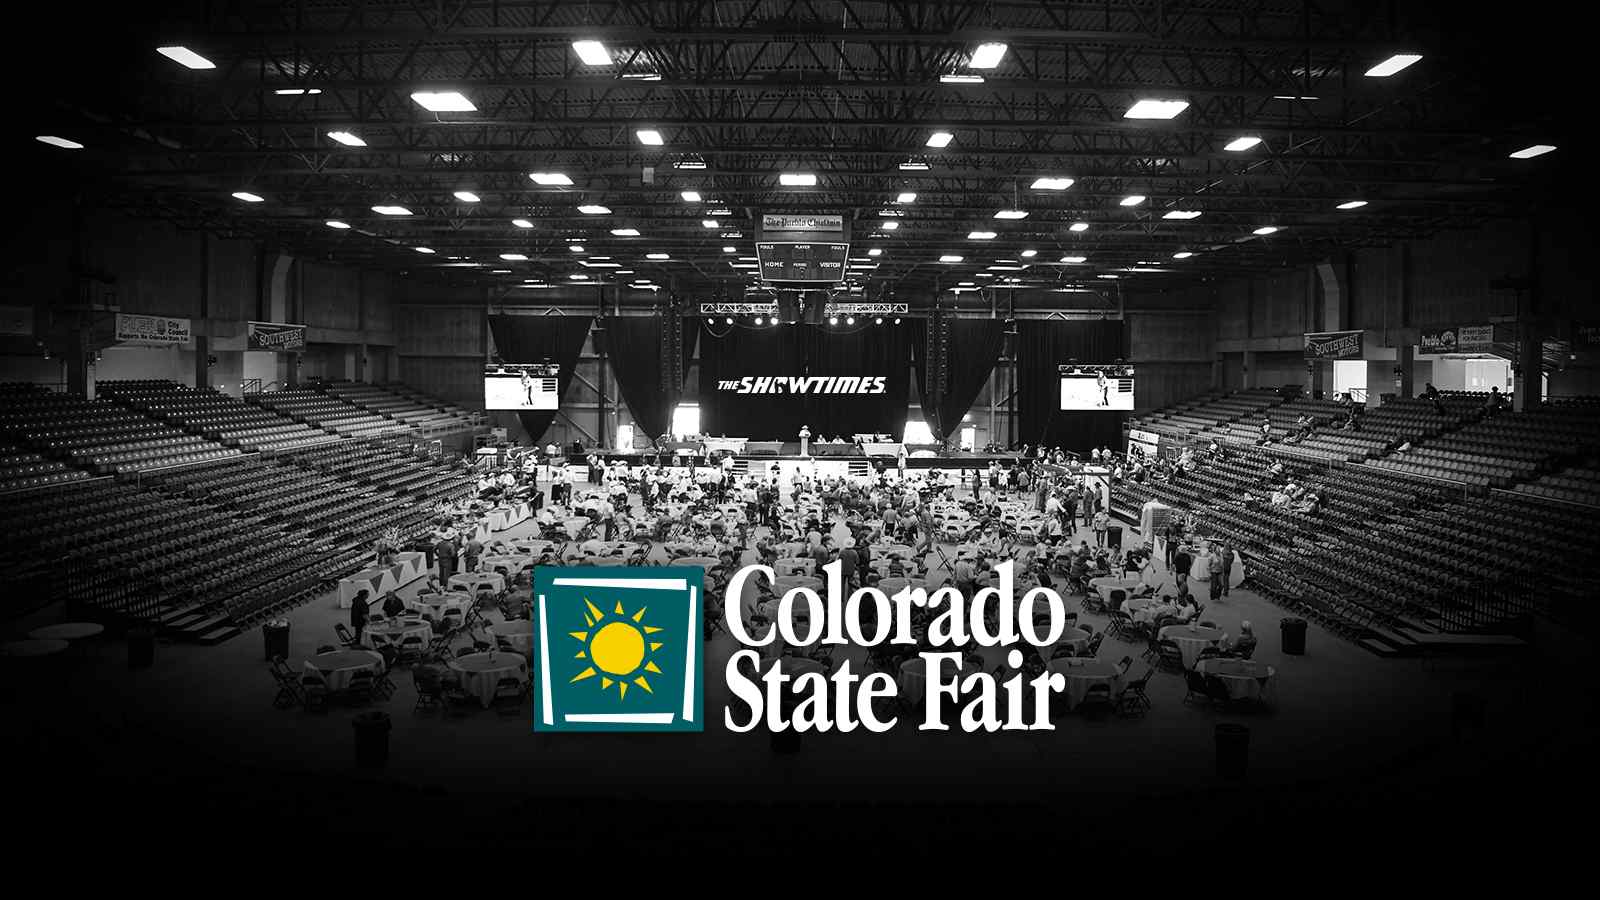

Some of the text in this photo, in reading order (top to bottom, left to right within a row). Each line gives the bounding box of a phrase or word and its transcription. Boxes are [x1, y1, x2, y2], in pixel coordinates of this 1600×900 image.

[766, 217, 780, 226] The
[167, 320, 180, 329] City
[1315, 333, 1360, 356] SOUTHWEST
